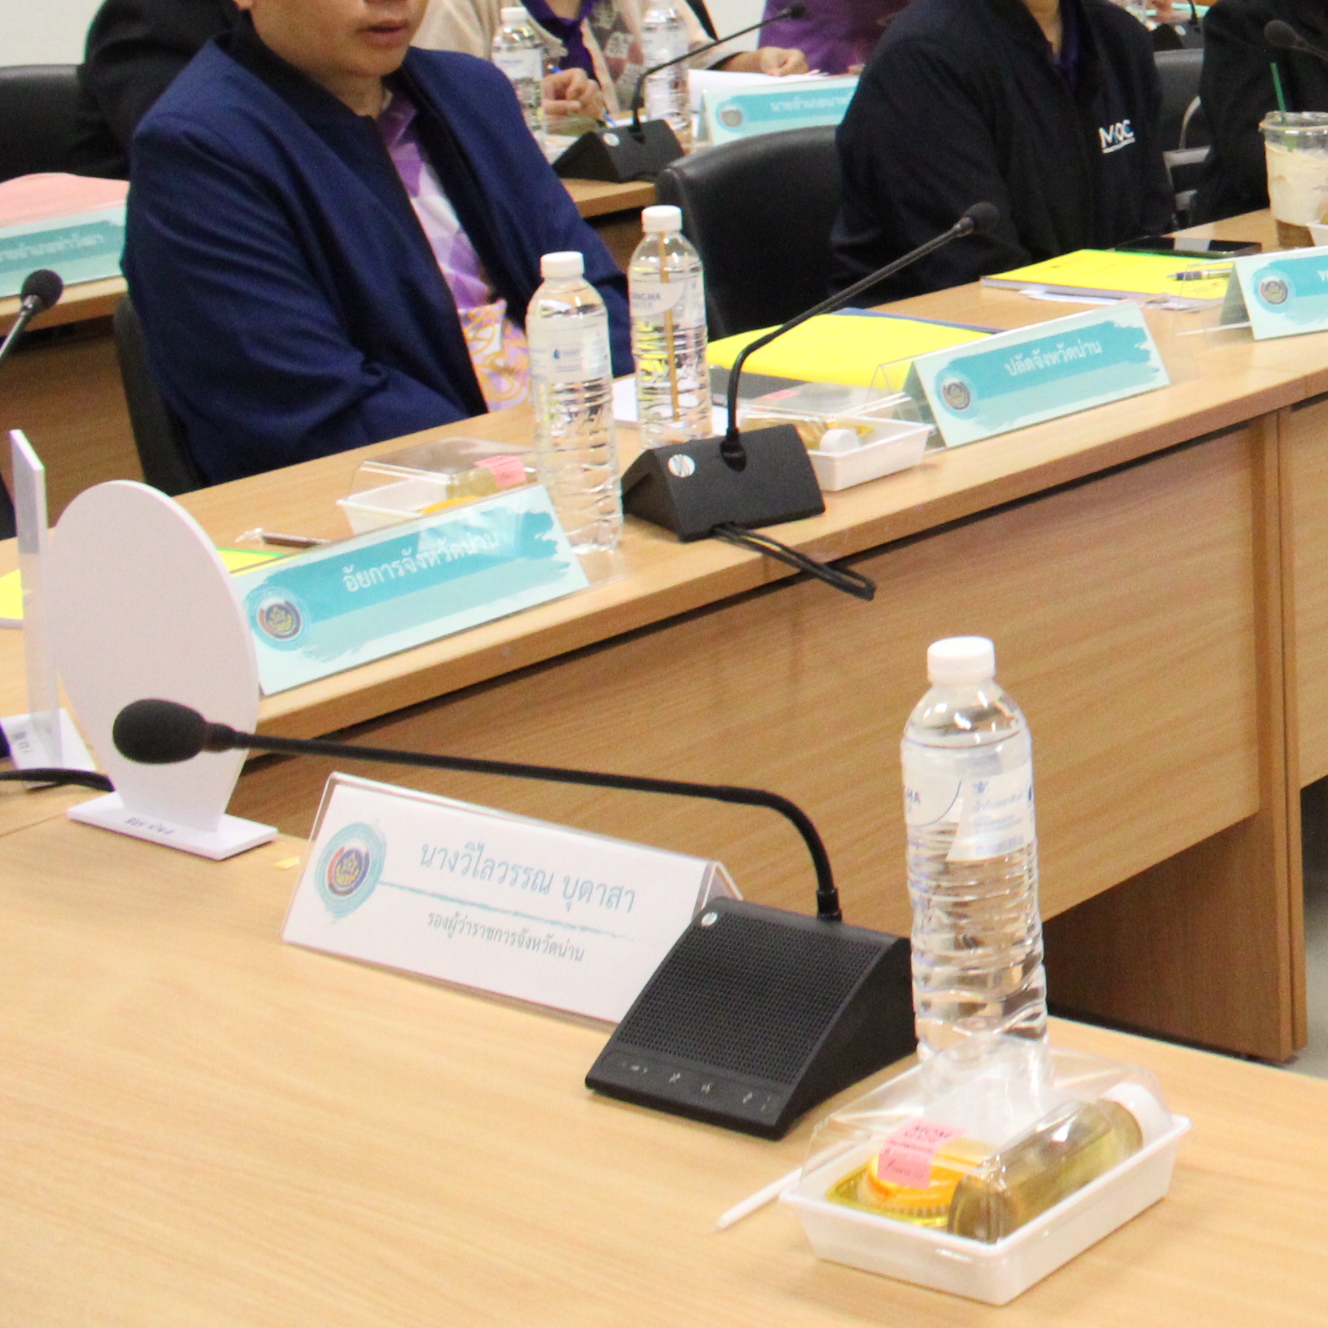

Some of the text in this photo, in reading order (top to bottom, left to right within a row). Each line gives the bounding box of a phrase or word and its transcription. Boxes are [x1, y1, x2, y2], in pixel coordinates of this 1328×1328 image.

[1004, 338, 1103, 377] ปลัดจังหวัดน่าน
[341, 528, 499, 593] อัยการจังหวัดน่าน
[419, 841, 636, 913] นางวิไลวรรณ บุดาสา
[427, 910, 585, 963] รองผู้ว่าราชการจังหวัดน่าน
